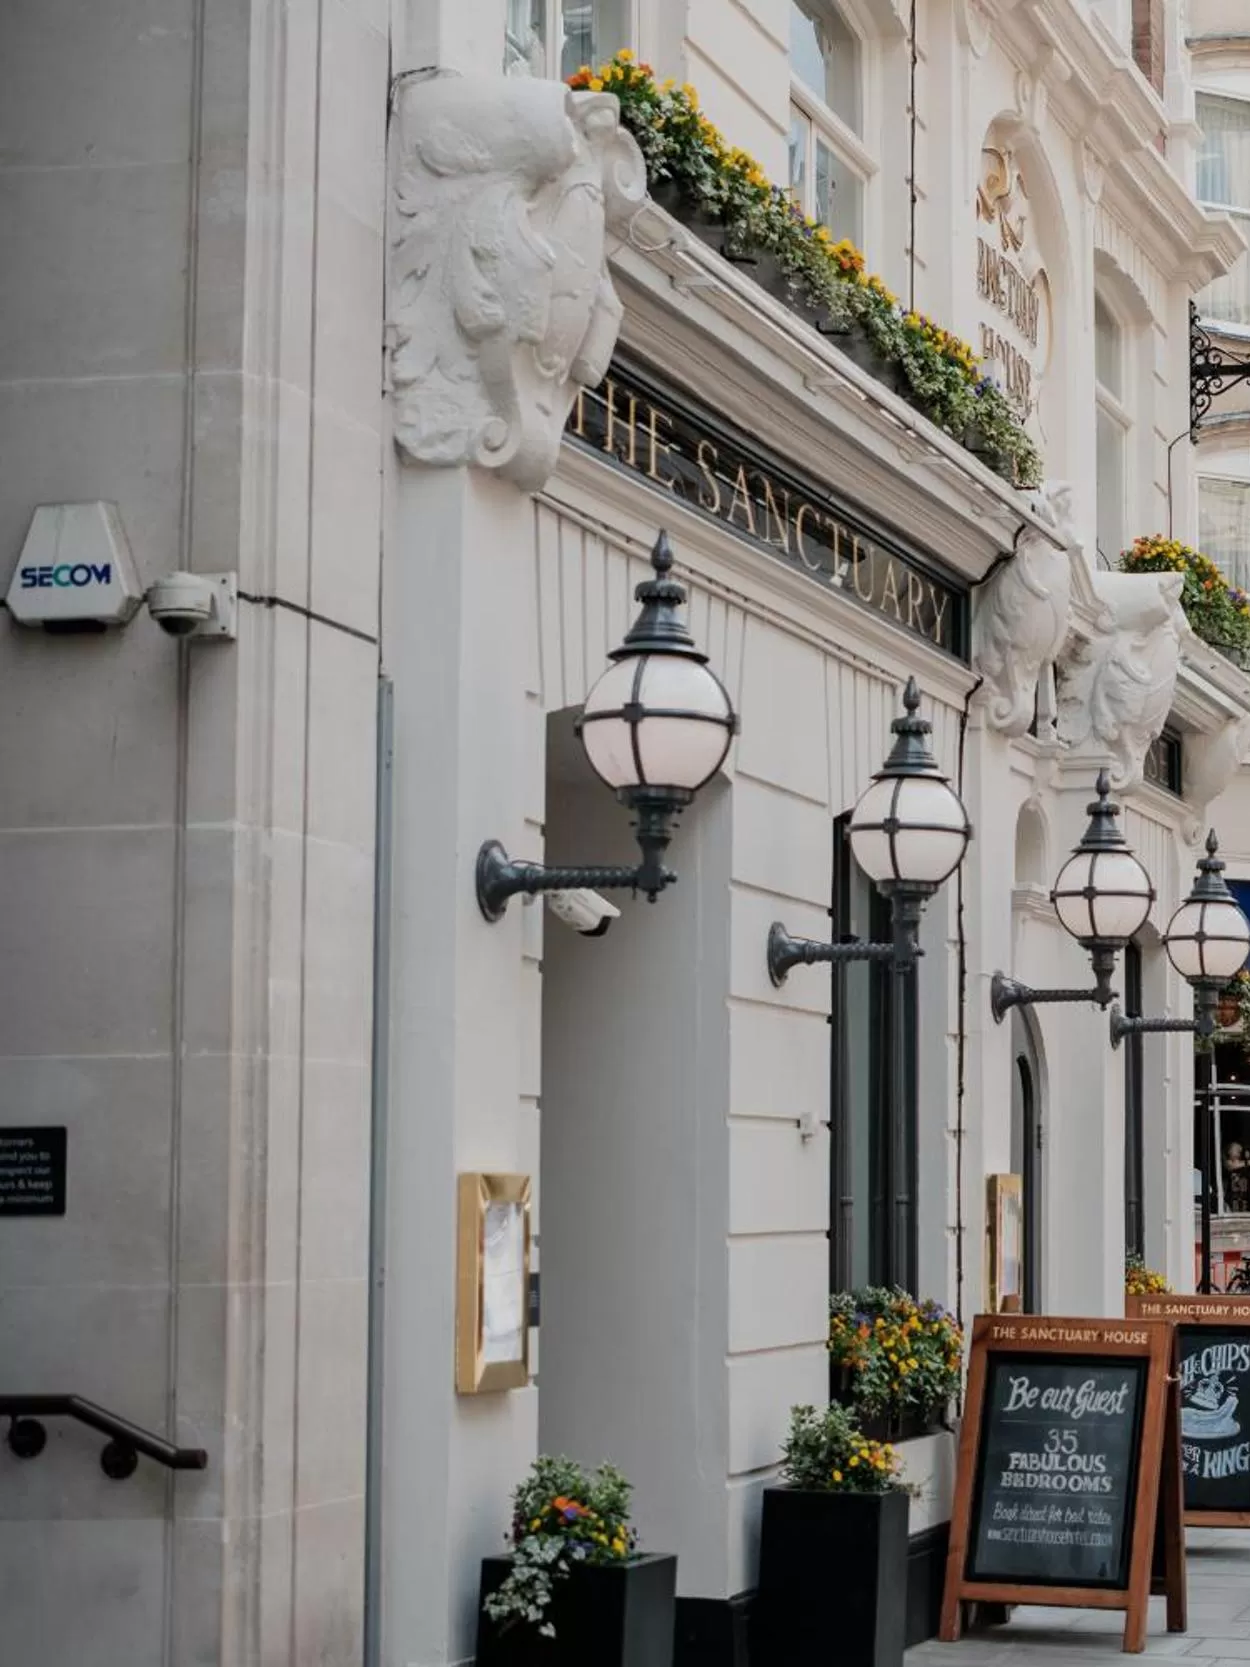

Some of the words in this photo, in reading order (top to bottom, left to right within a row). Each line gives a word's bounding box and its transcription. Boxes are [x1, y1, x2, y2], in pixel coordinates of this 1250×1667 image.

[698, 439, 948, 645] SANCTUARY
[21, 564, 111, 588] SECOM
[1141, 1304, 1161, 1314] THE
[1165, 1304, 1230, 1316] SANCTUARY
[993, 1326, 1016, 1339] THE
[1020, 1327, 1100, 1342] SANCTUARY
[1103, 1331, 1148, 1344] HOUSE
[1201, 1343, 1250, 1377] CHIPS
[1002, 1375, 1041, 1412] Be
[1040, 1385, 1075, 1413] our
[1070, 1379, 1129, 1419] Guest
[1044, 1428, 1078, 1454] 35
[1008, 1451, 1106, 1473] FABULOUS
[1202, 1441, 1250, 1479] KING
[1000, 1471, 1113, 1492] BEDROOMS
